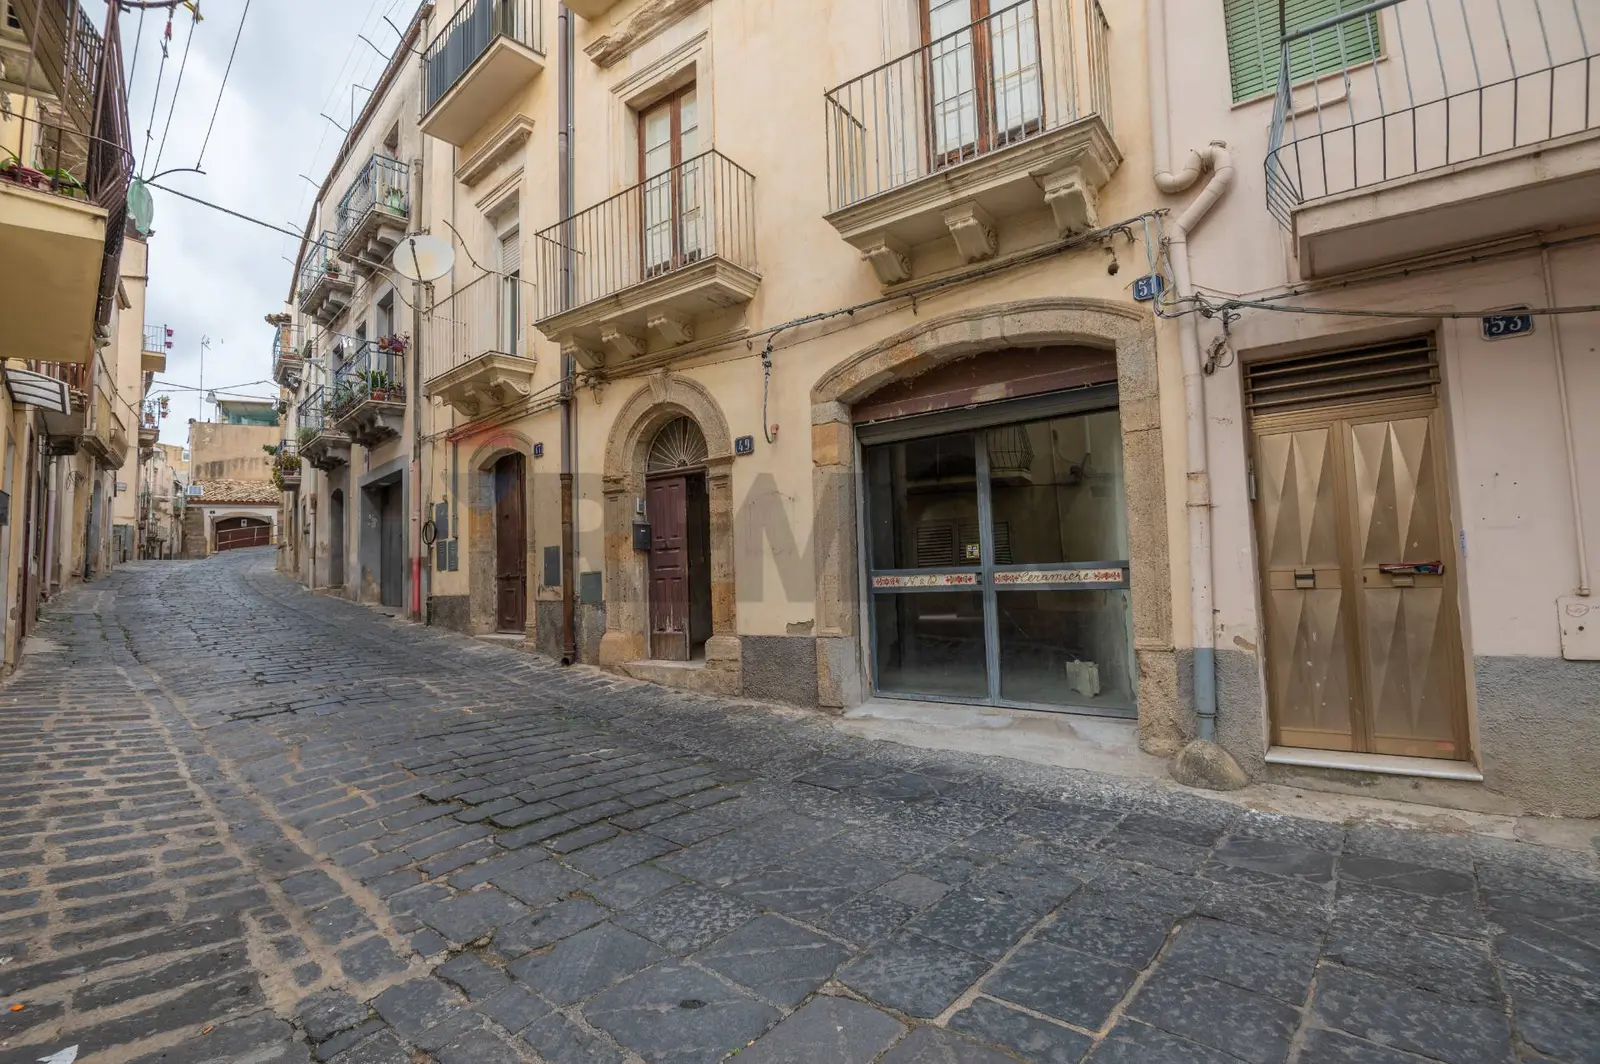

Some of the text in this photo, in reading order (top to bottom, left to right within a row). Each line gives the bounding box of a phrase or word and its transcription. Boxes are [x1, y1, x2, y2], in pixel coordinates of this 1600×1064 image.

[1138, 279, 1156, 296] 51
[1491, 314, 1522, 333] 53
[1018, 569, 1091, 583] Ceramiche
